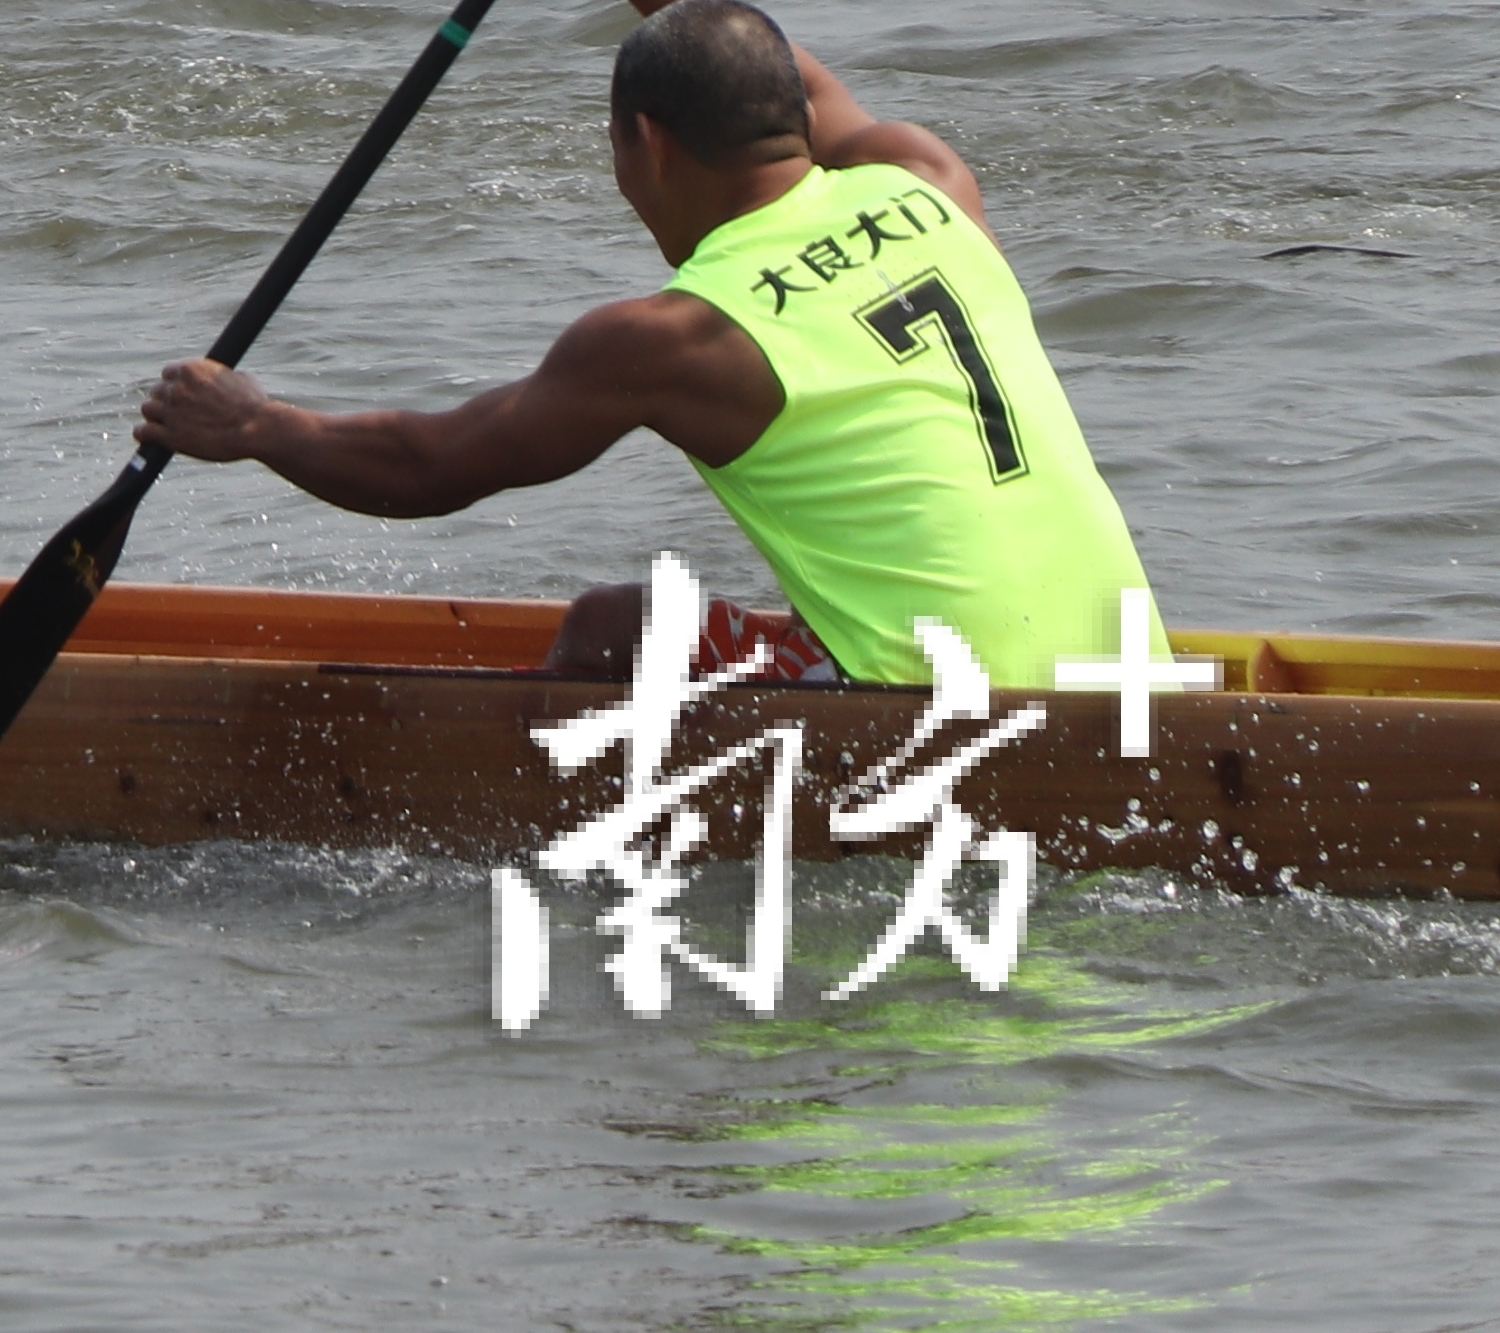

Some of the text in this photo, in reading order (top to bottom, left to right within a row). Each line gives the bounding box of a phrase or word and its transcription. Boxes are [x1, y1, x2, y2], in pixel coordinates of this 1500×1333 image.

[749, 187, 951, 317] 大良大门
[852, 265, 1030, 486] 7
